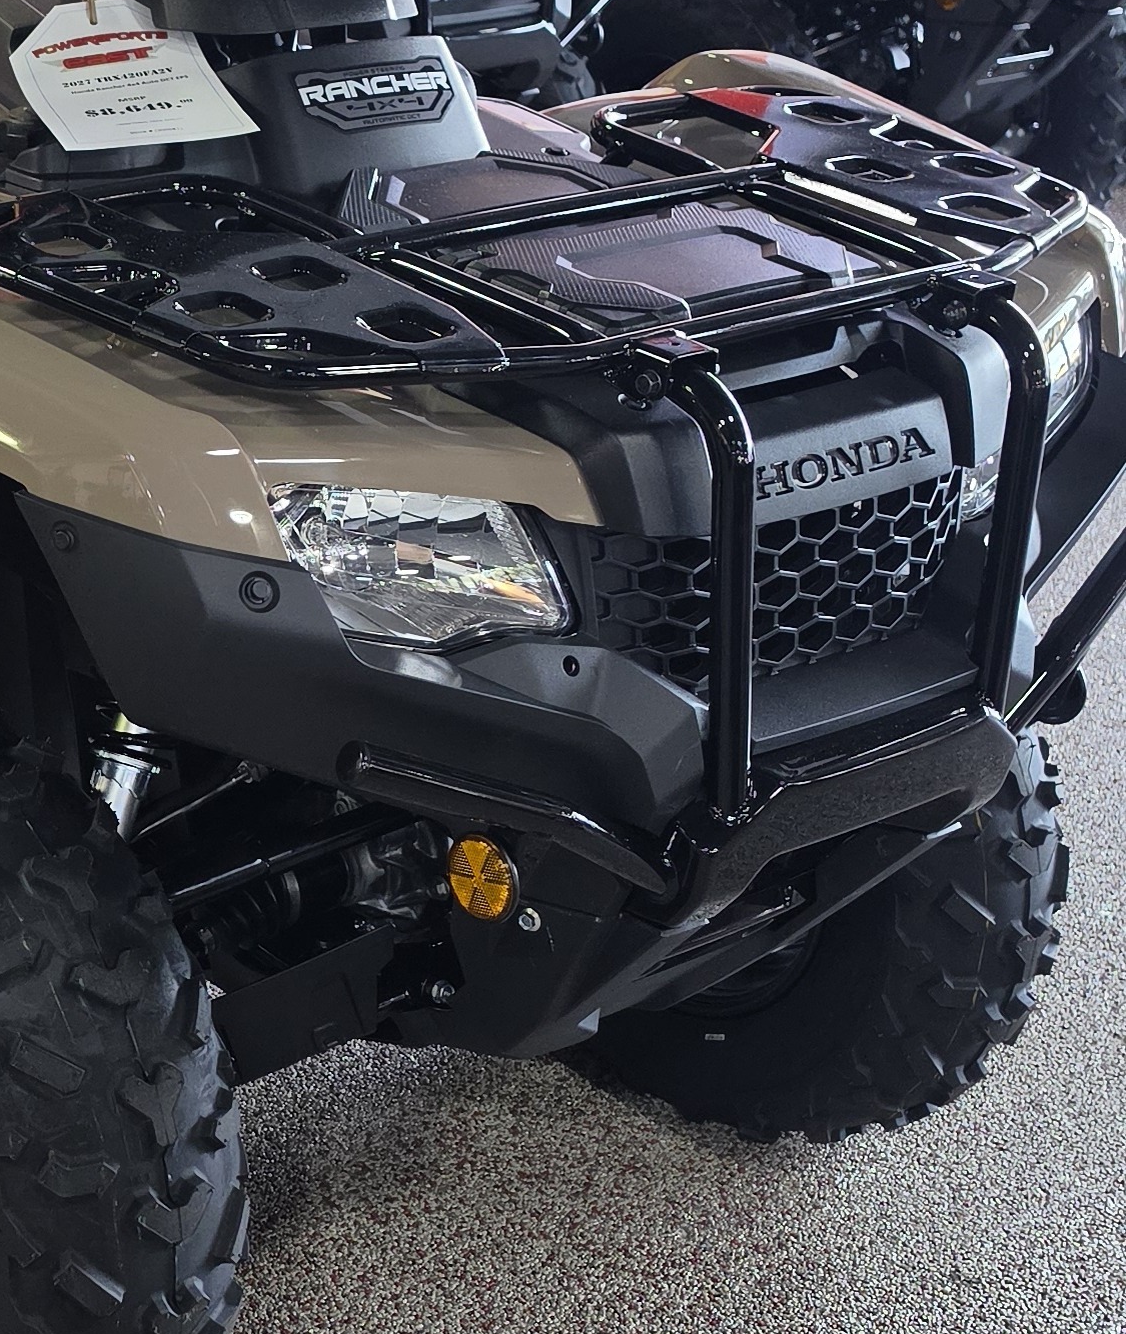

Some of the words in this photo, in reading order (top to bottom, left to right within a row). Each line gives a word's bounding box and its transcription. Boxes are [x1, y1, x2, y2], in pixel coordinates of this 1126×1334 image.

[31, 31, 169, 59] POWERSPORTS
[62, 79, 91, 88] 2027
[298, 71, 451, 106] RANCHER
[117, 95, 146, 103] MSRP
[362, 115, 407, 125] AUTOMATIC
[756, 427, 936, 500] HONDA
